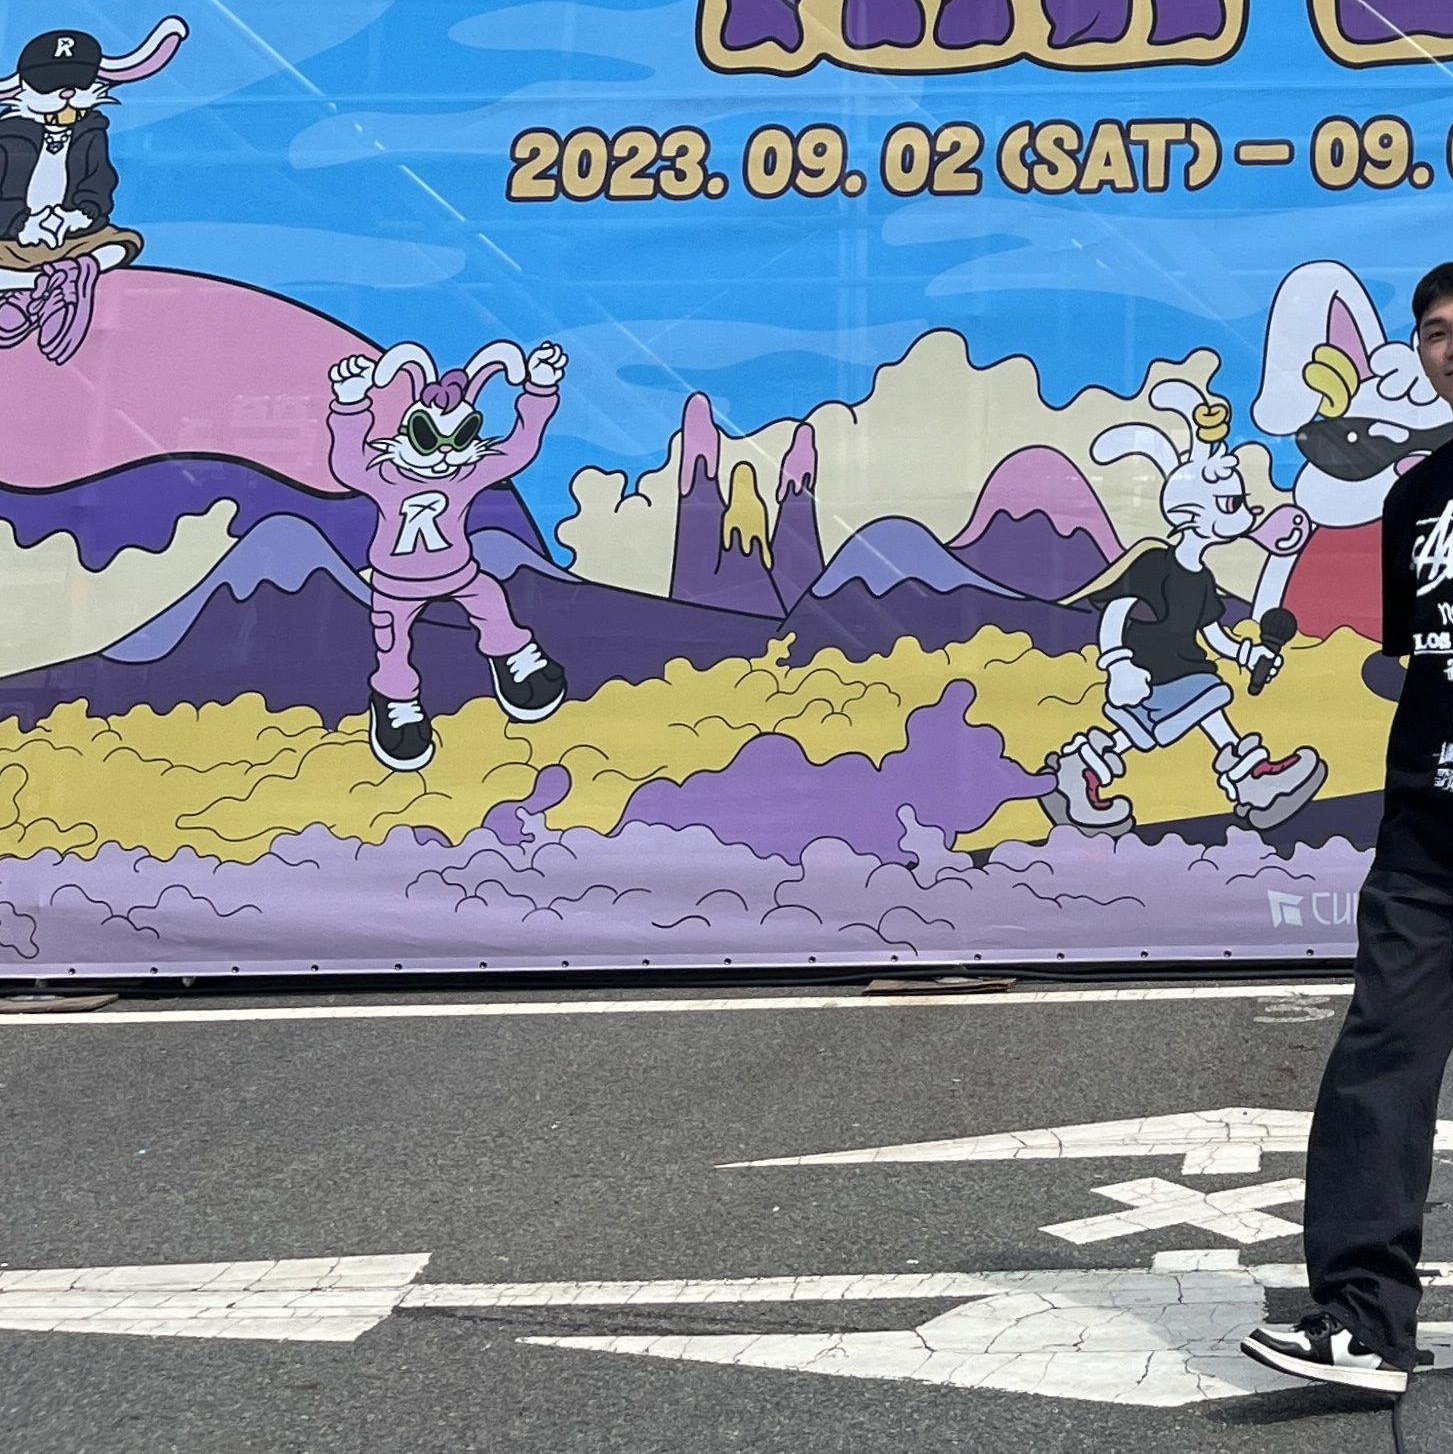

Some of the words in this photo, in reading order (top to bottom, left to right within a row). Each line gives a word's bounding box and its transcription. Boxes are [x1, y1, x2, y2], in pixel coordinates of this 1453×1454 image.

[506, 127, 729, 202] 2023.
[743, 124, 867, 199] 09.
[880, 121, 981, 196] 02
[996, 119, 1220, 193] (SAT)
[1309, 115, 1434, 189] 09.
[1412, 631, 1452, 650] LOS
[1311, 892, 1360, 925] CU
